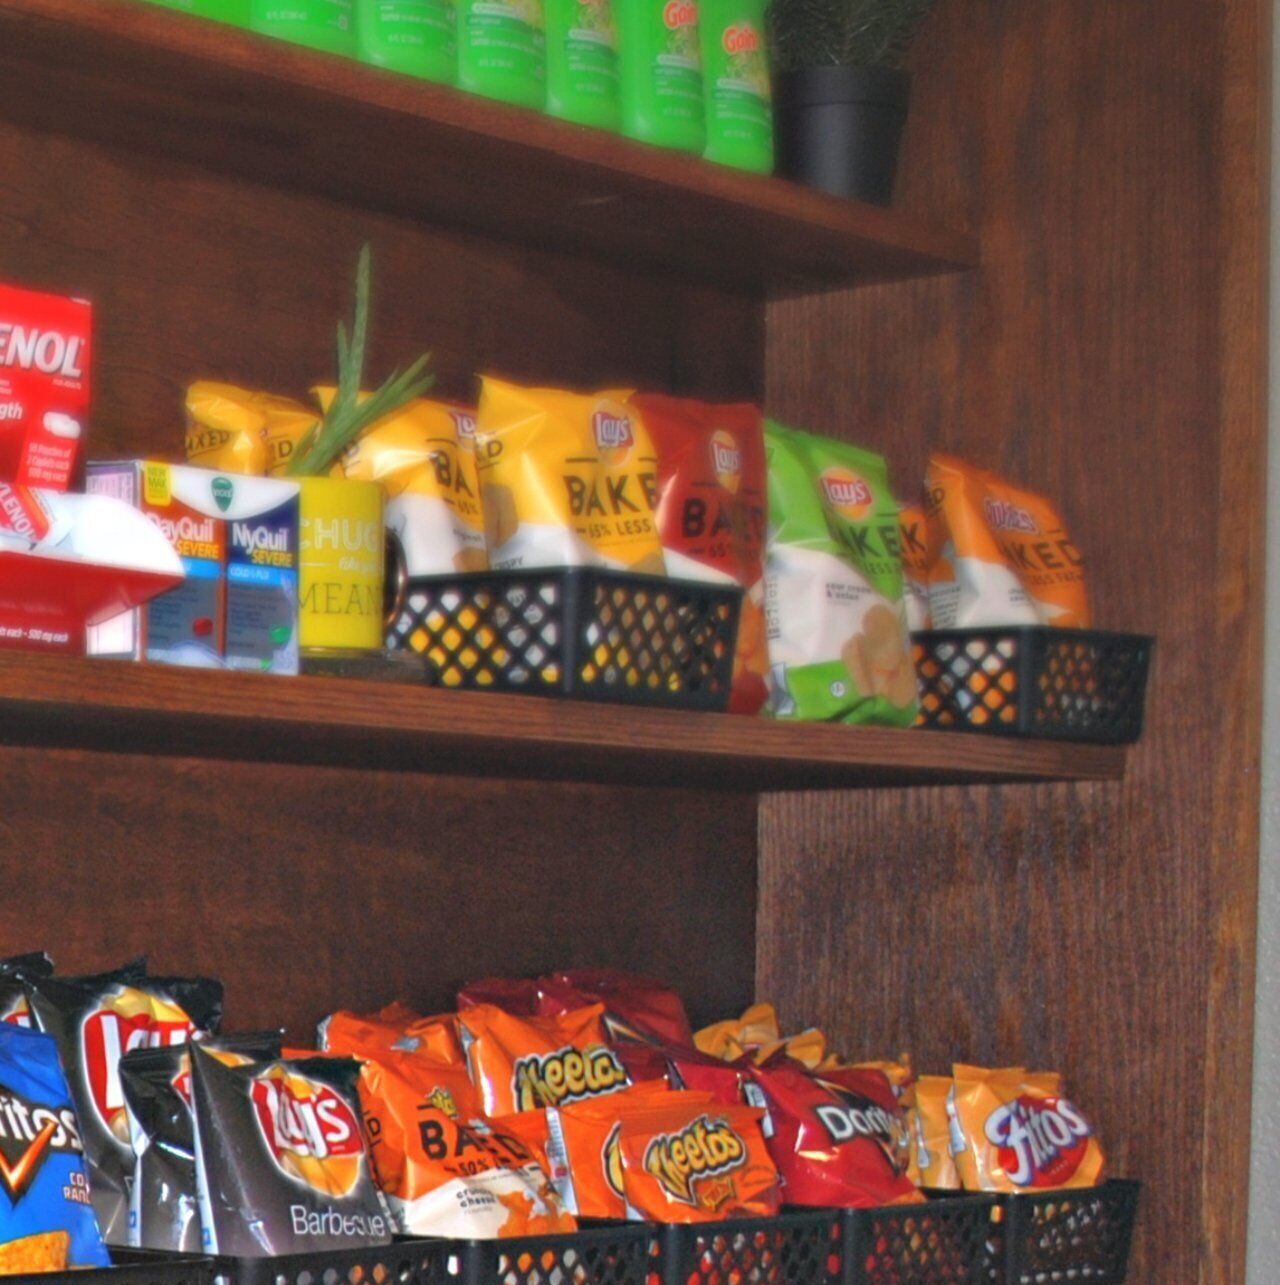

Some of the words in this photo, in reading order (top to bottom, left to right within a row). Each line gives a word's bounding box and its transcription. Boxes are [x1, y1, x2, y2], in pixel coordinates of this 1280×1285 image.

[722, 25, 758, 55] Gain
[596, 411, 631, 449] Lay's
[711, 440, 740, 474] Lay's
[823, 478, 866, 506] Lay's
[232, 522, 288, 554] NyQuil
[616, 519, 652, 537] LESS
[176, 541, 219, 558] SEVERE
[252, 550, 293, 568] SEVERE
[7, 627, 23, 638] each
[42, 630, 53, 642] mg
[53, 632, 68, 643] each
[262, 1076, 350, 1160] Lay's
[985, 1097, 1088, 1184] Fritos
[644, 1113, 745, 1204] Cheetos
[290, 1206, 386, 1239] Barbecue
